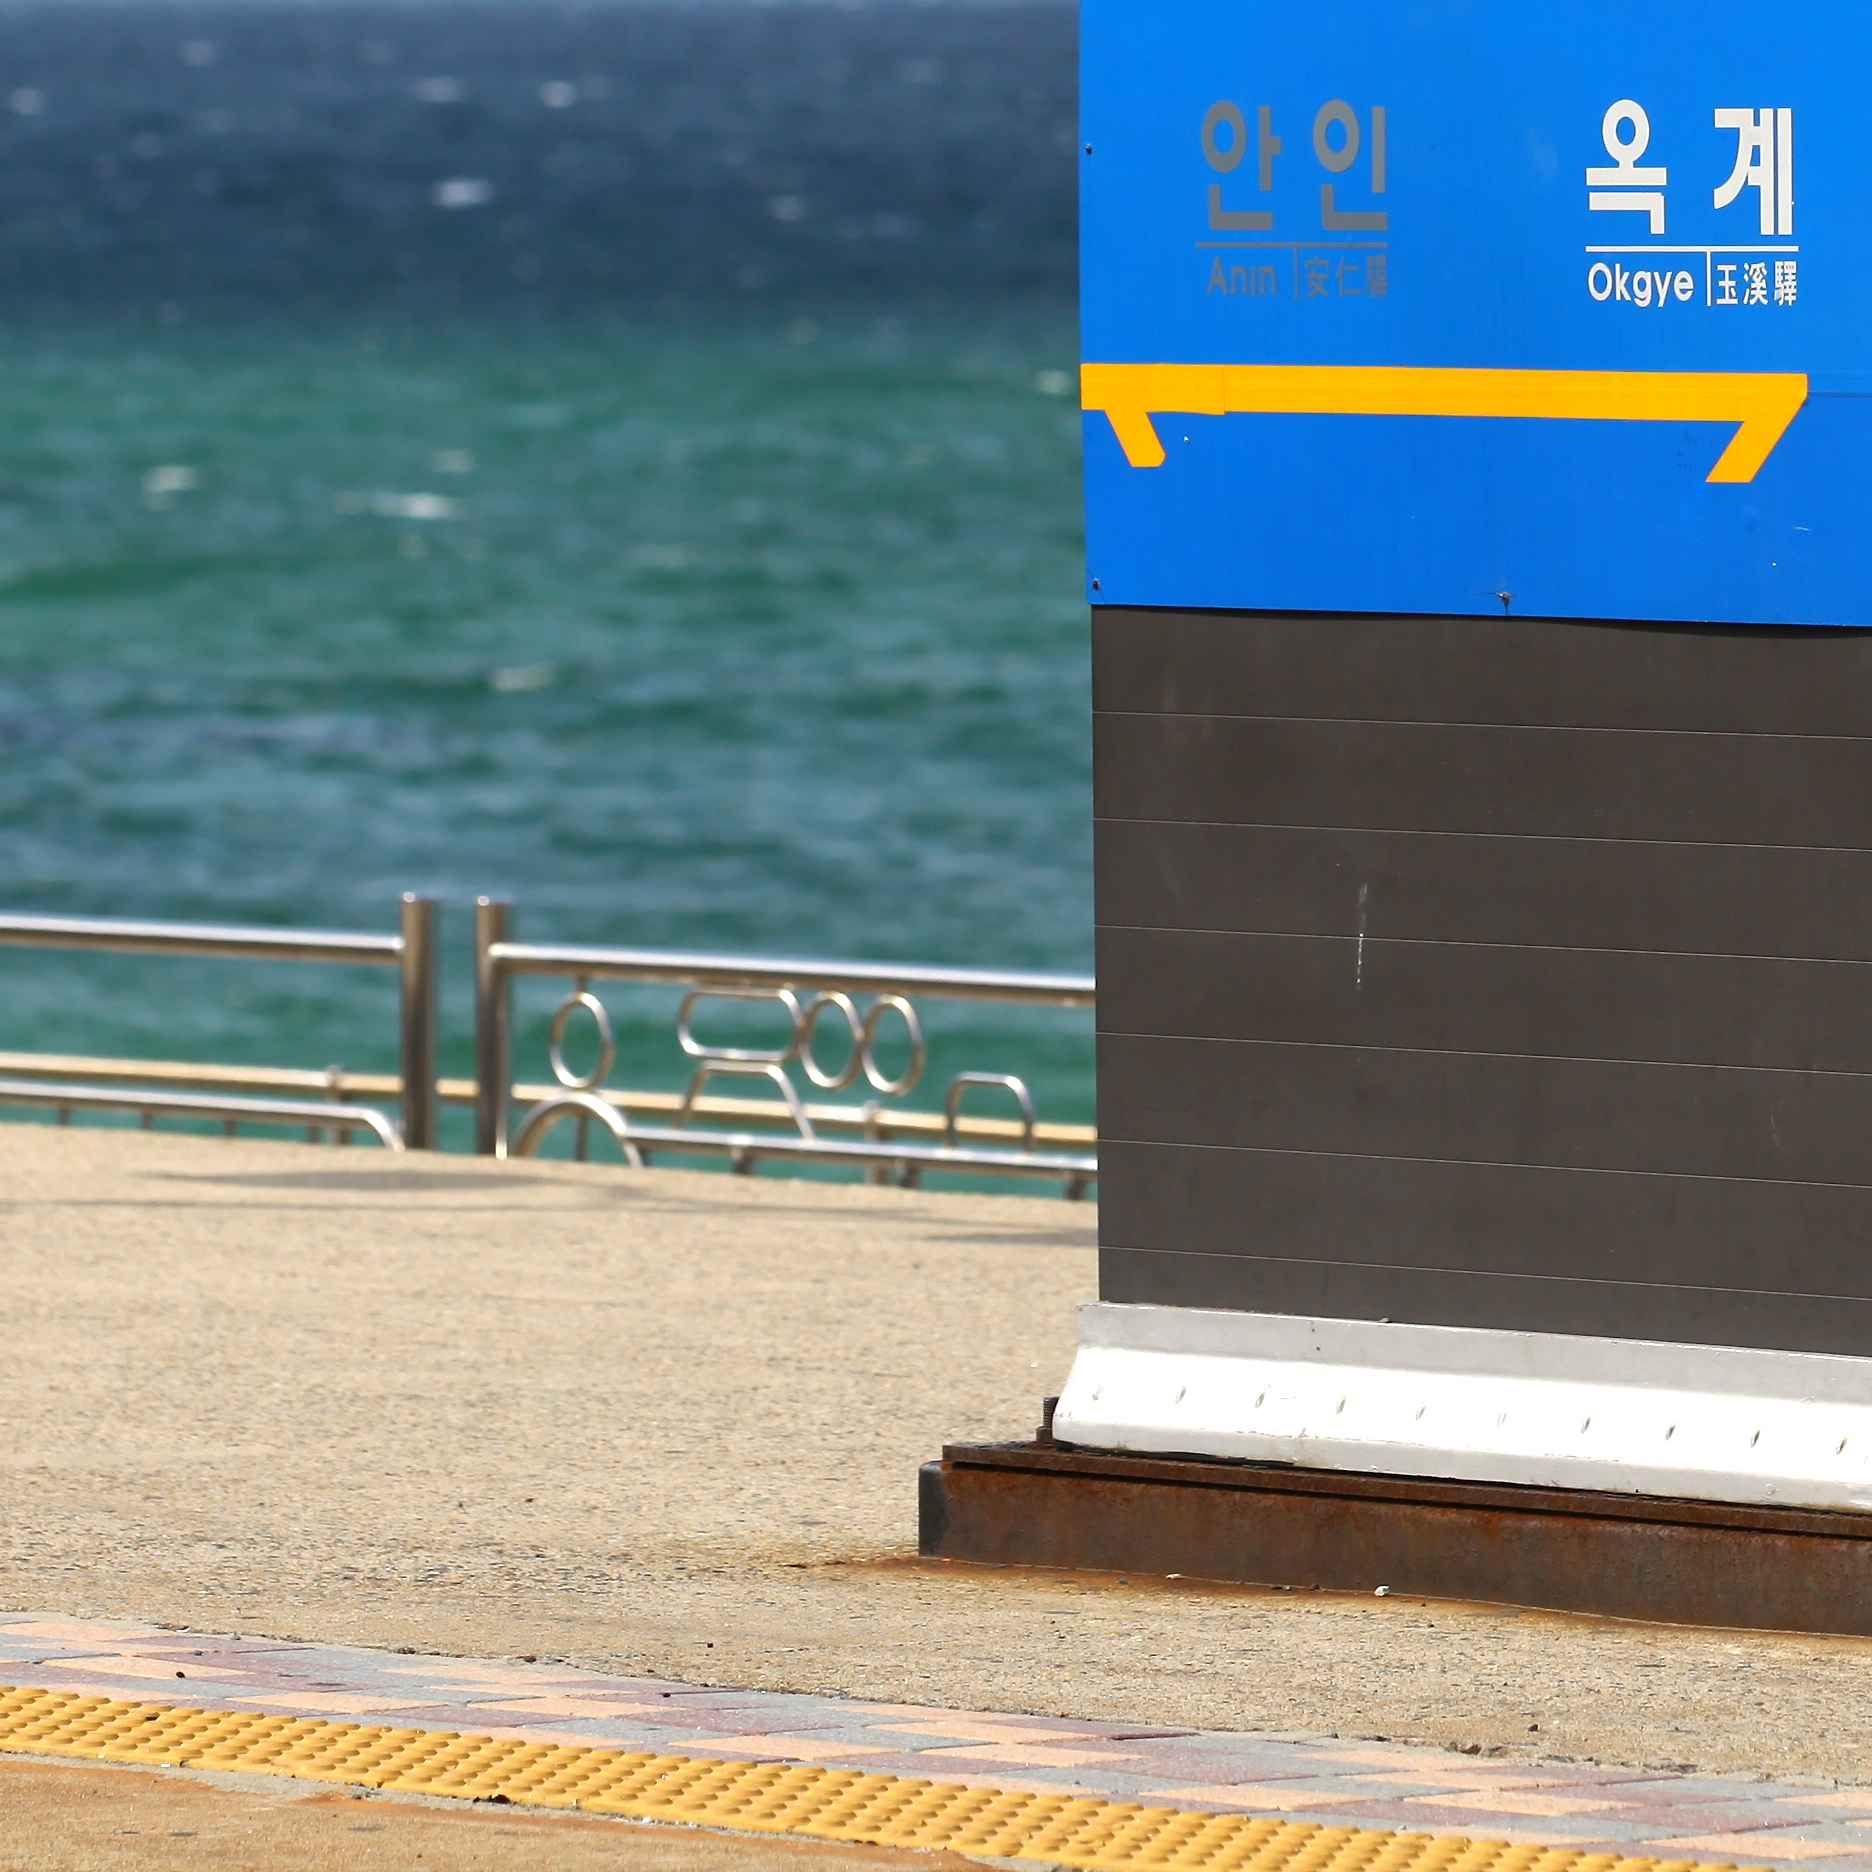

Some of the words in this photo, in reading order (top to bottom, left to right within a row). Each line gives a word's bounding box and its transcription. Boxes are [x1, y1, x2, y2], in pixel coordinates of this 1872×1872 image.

[1587, 262, 1694, 308] Okgye
[1716, 260, 1797, 306] 玉溪驛
